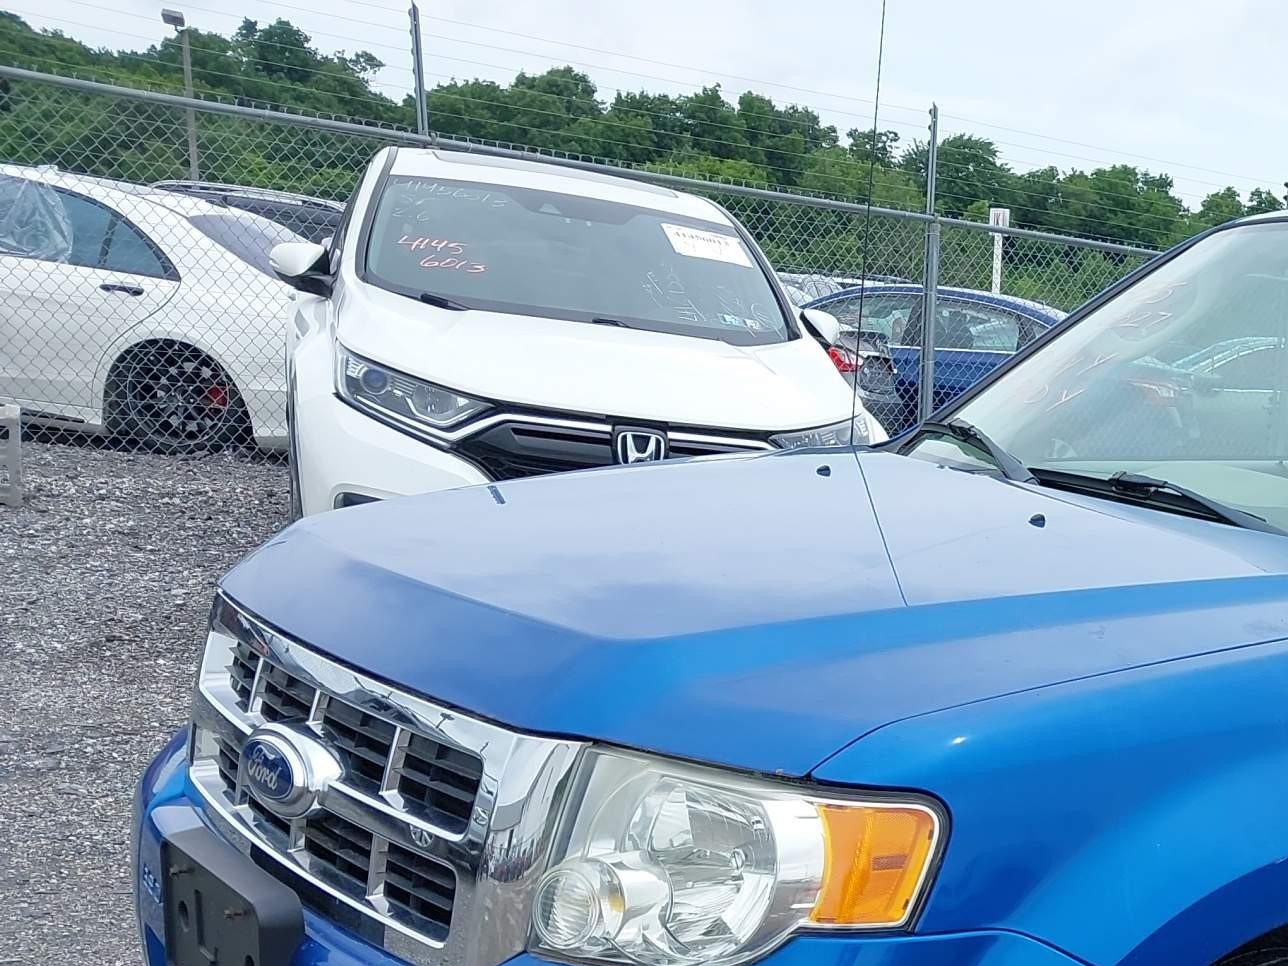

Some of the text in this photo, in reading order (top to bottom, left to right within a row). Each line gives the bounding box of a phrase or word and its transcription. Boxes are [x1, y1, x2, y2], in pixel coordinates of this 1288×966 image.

[397, 235, 468, 255] 4145
[419, 254, 487, 273] 6013
[247, 744, 283, 791] Ford
